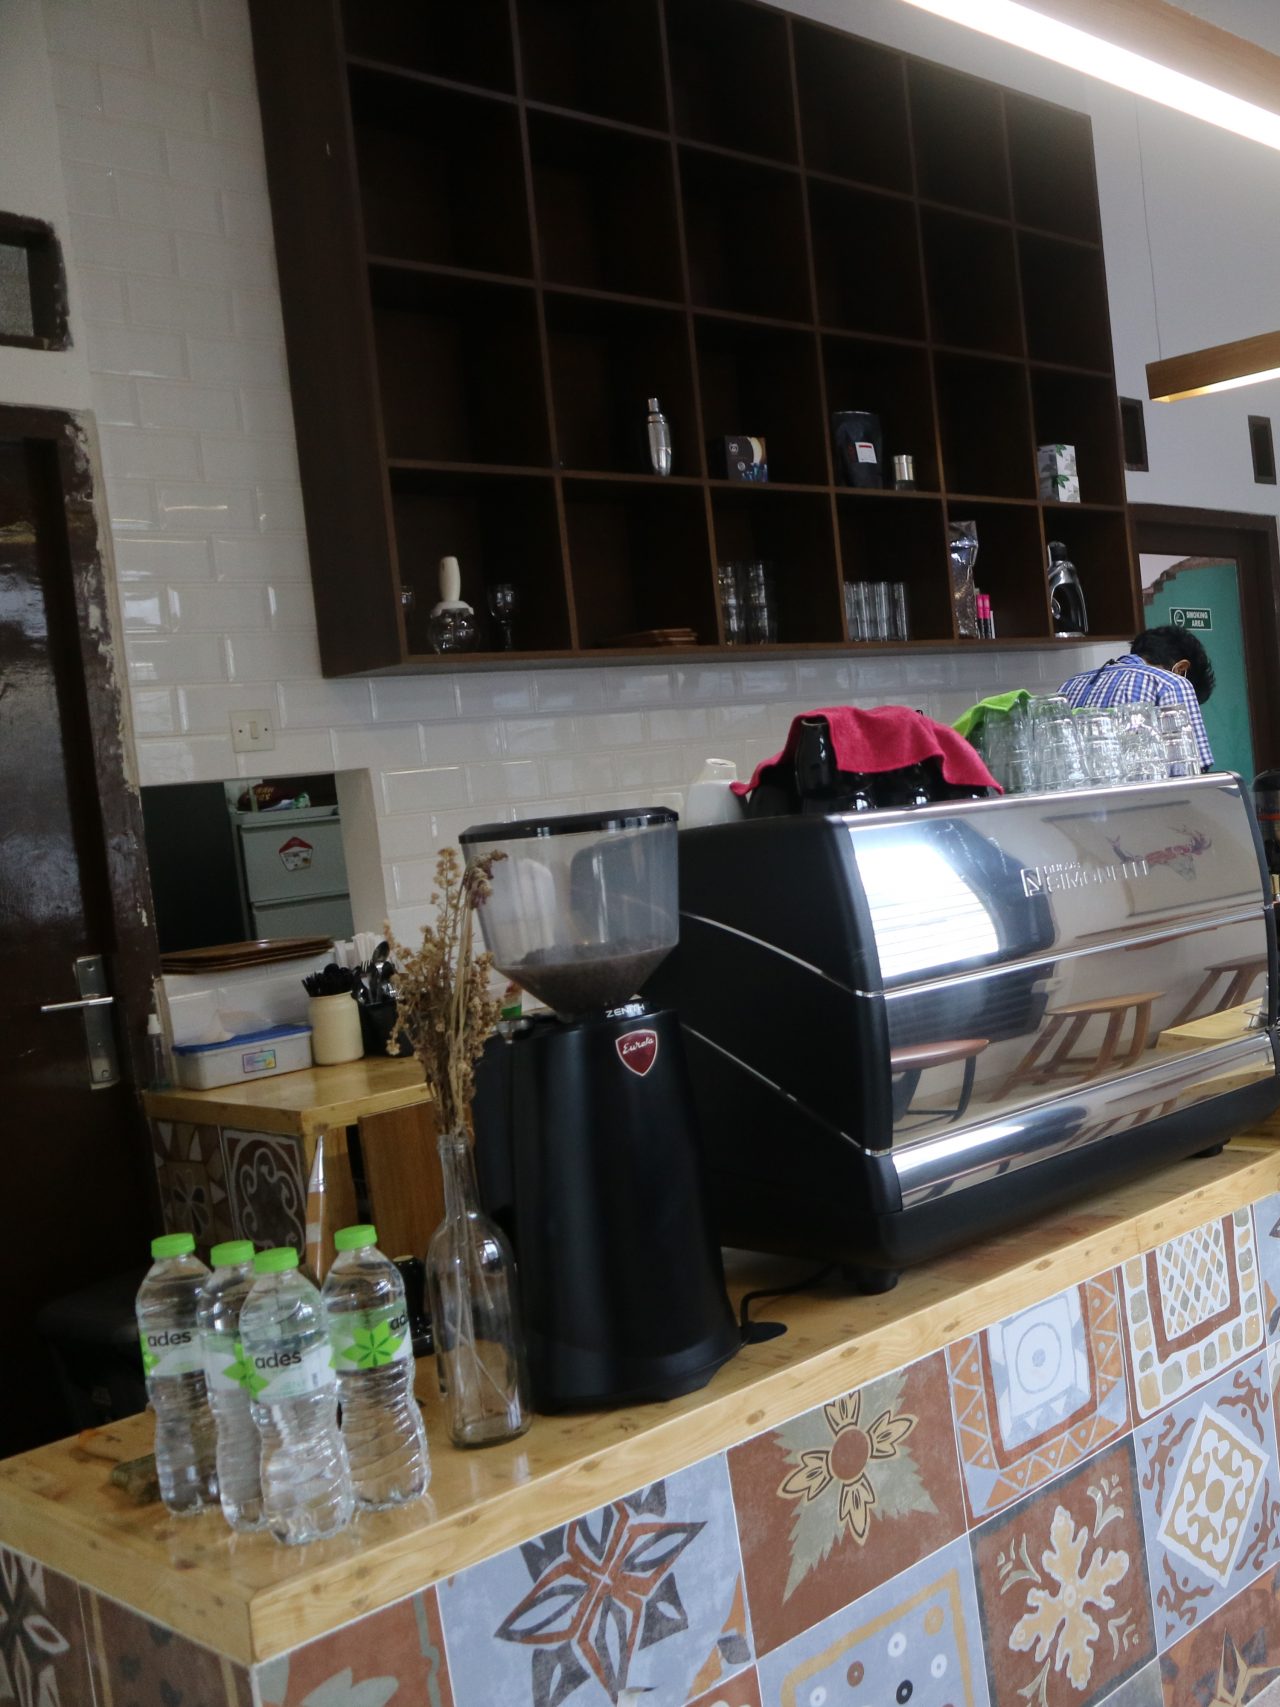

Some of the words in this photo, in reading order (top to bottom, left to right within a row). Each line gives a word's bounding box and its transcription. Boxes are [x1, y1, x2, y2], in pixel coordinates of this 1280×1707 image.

[1186, 611, 1208, 619] SMOKING
[605, 1003, 645, 1018] ZENITH
[622, 1037, 654, 1055] Eureka
[147, 1330, 192, 1348] ades
[254, 1350, 302, 1370] ades
